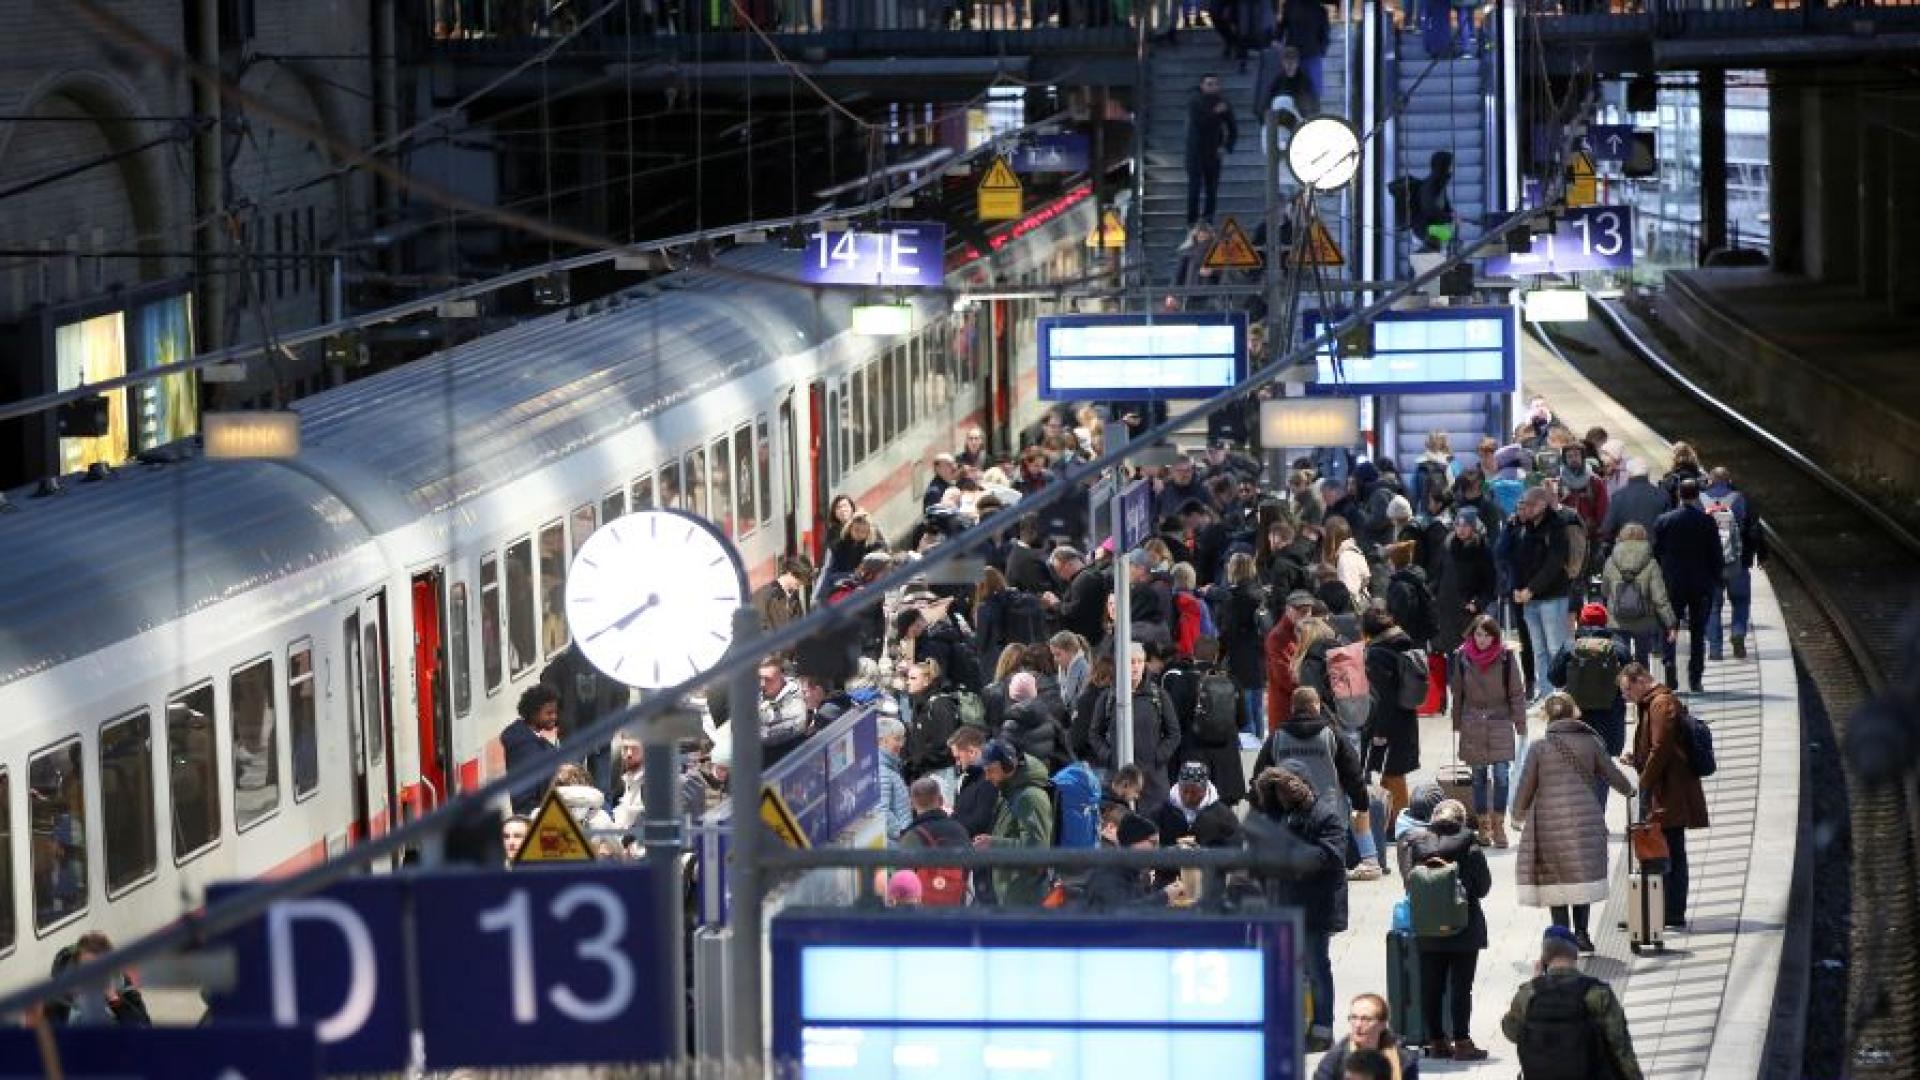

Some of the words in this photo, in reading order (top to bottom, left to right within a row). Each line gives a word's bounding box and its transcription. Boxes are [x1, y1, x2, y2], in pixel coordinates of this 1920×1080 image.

[811, 229, 859, 270] 14
[890, 229, 920, 275] E
[1572, 212, 1622, 256] 13
[268, 898, 377, 1042] D
[479, 884, 636, 1024] 13
[1171, 951, 1229, 1005] 13
